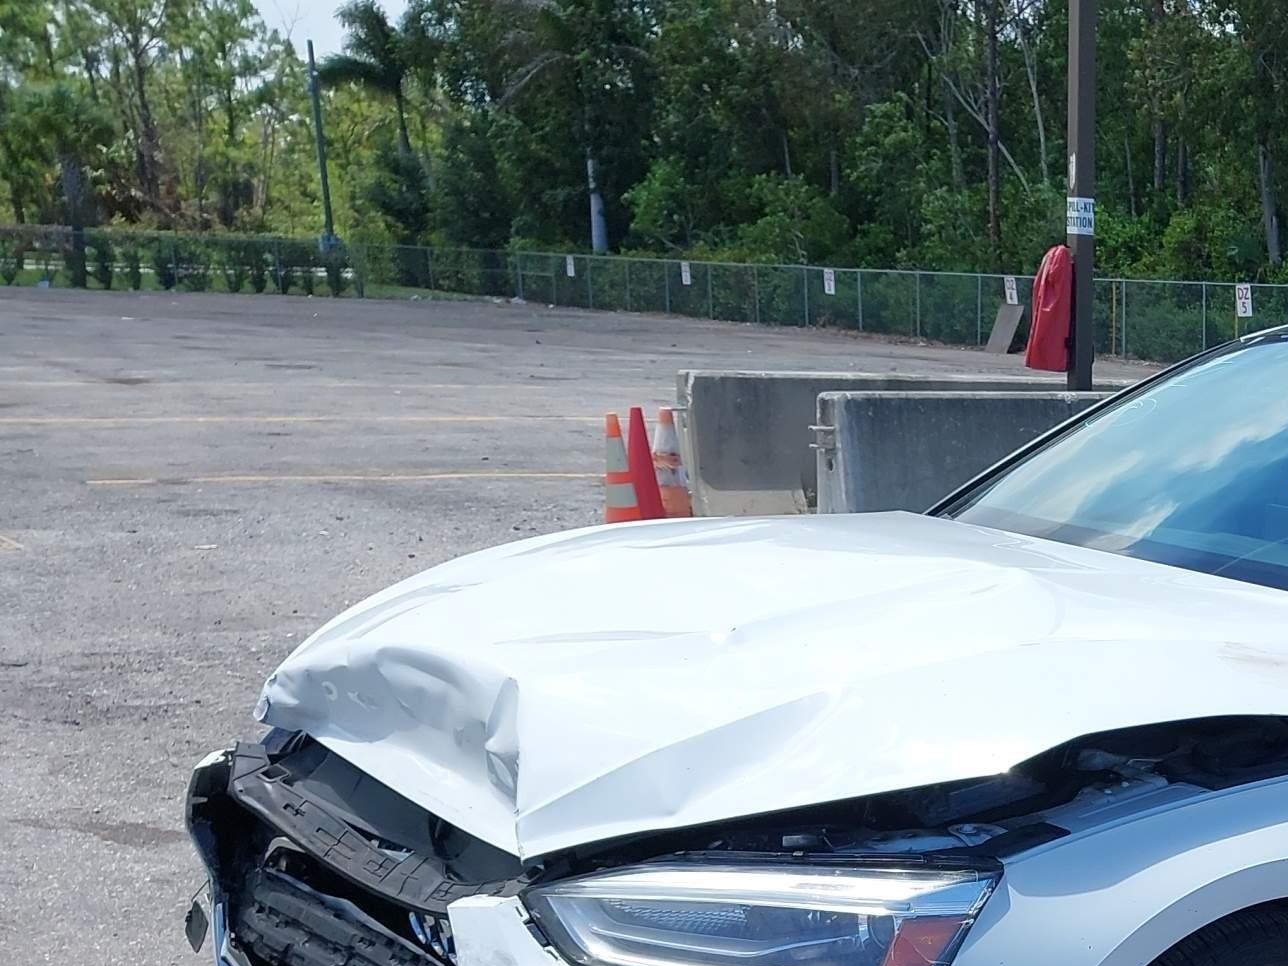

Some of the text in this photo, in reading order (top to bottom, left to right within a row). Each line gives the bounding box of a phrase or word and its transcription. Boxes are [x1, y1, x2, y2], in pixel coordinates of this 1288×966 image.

[1067, 216, 1093, 229] STATION
[1237, 287, 1250, 300] DZ
[1241, 301, 1248, 314] 5
